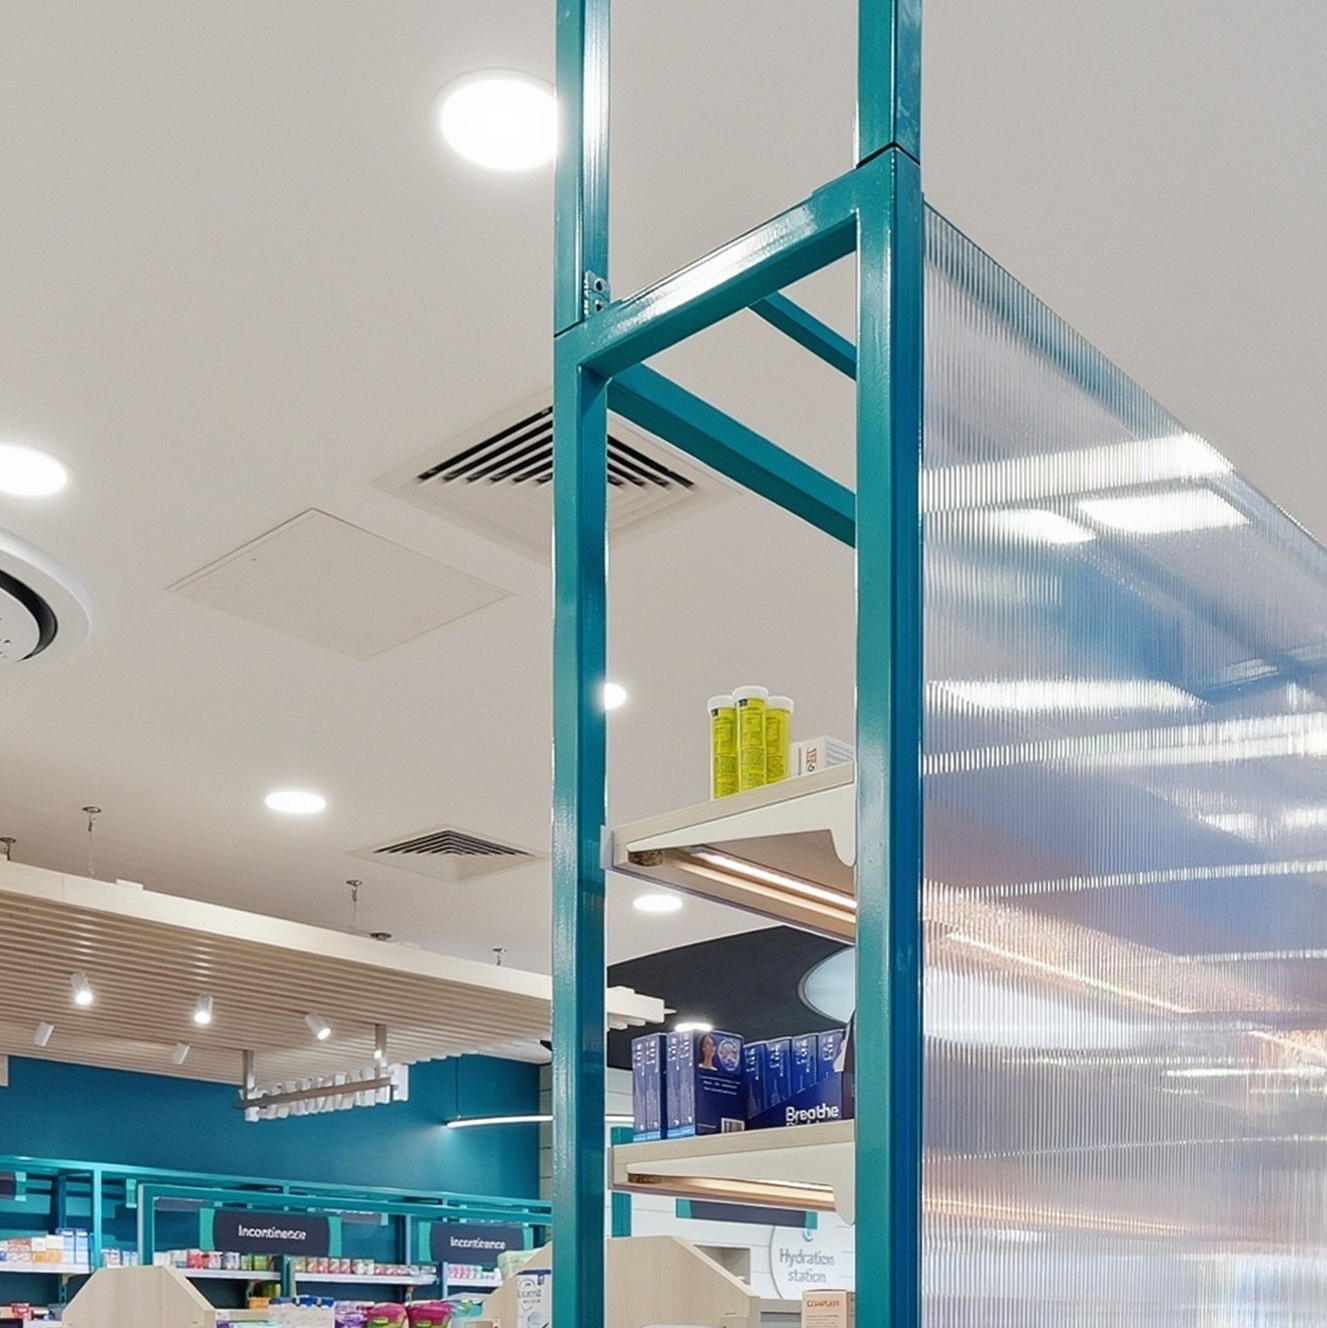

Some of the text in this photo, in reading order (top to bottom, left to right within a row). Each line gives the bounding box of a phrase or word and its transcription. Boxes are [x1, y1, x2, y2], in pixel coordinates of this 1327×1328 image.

[785, 1103, 839, 1122] Breathe
[238, 1224, 307, 1240] Incontinence
[450, 1236, 506, 1250] Incontinence
[779, 1248, 835, 1268] Hydration
[788, 1269, 827, 1283] station
